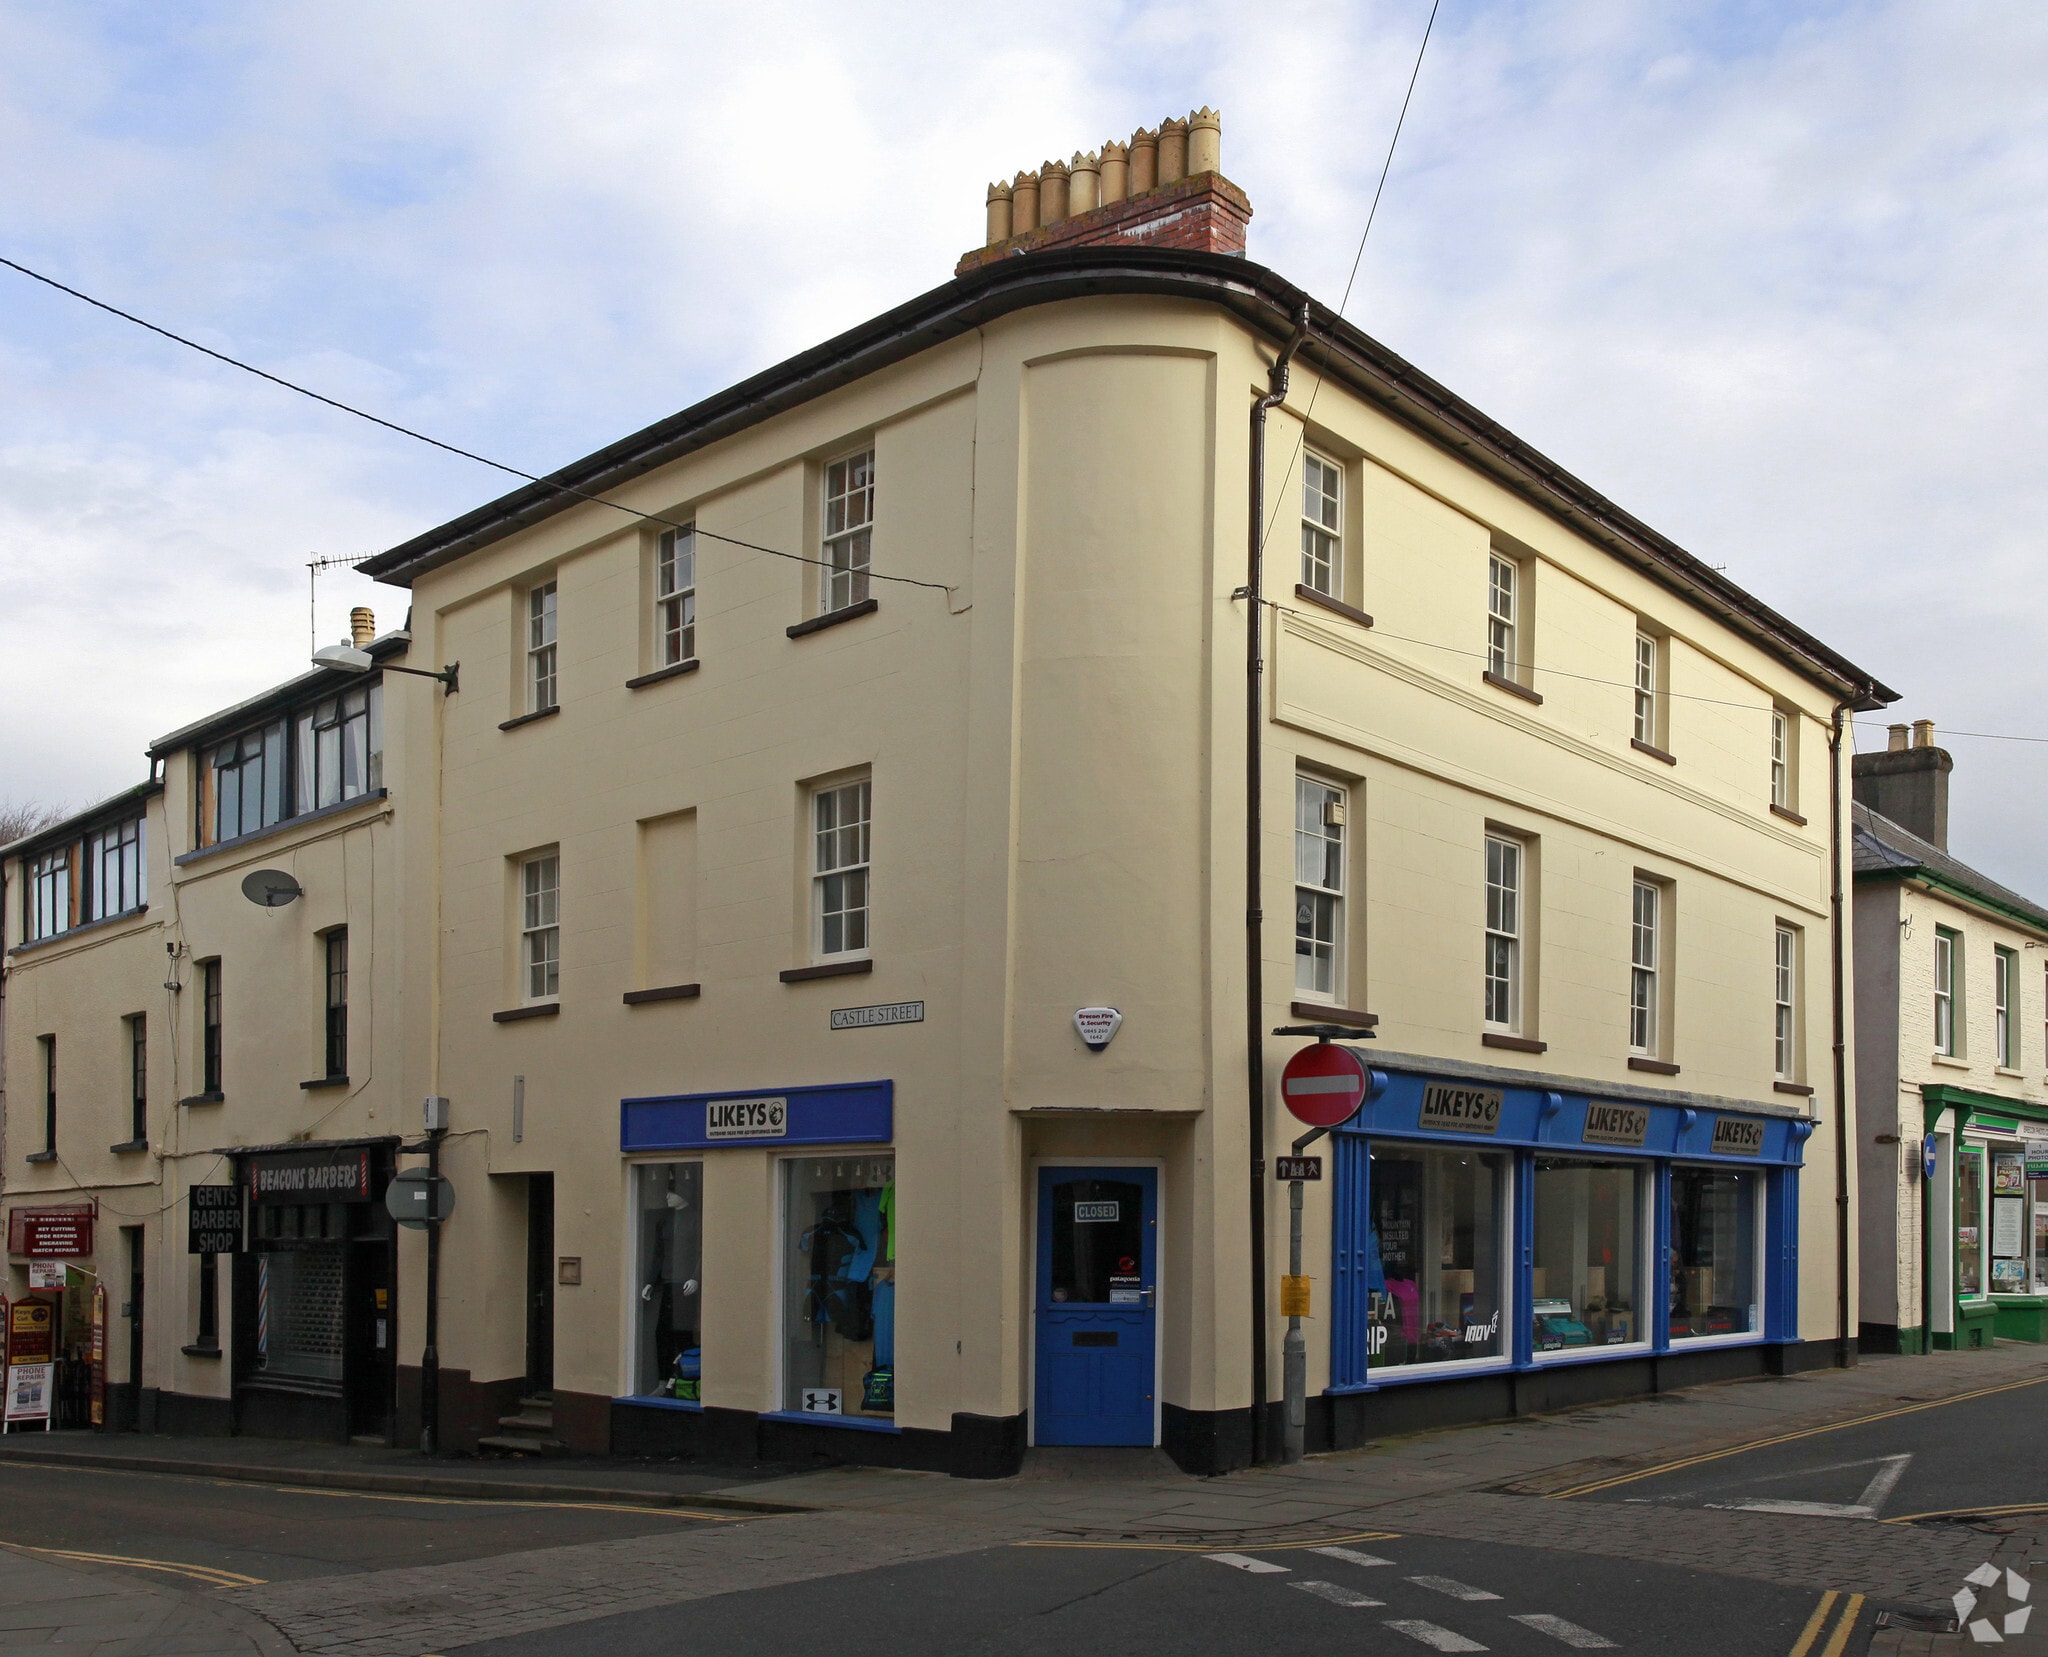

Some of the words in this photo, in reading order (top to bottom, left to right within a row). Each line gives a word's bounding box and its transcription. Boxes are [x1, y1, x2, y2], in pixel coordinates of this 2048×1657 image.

[833, 1009, 875, 1026] CASTLE
[877, 1004, 919, 1021] STREET
[1424, 1087, 1485, 1120] LIKEYS
[709, 1103, 767, 1128] LIKEYS
[1587, 1106, 1635, 1134] LIKEYS
[1715, 1121, 1754, 1145] LIKEYS
[260, 1167, 306, 1192] BEACONS
[308, 1164, 358, 1190] BARBERS
[196, 1187, 237, 1207] GENTS
[191, 1209, 241, 1229] BARBER
[1078, 1206, 1115, 1218] CLOSED
[200, 1232, 233, 1251] SHOP
[1382, 1230, 1409, 1240] INSULTED
[1382, 1251, 1406, 1262] MOTHER
[17, 1366, 46, 1375] PHONE
